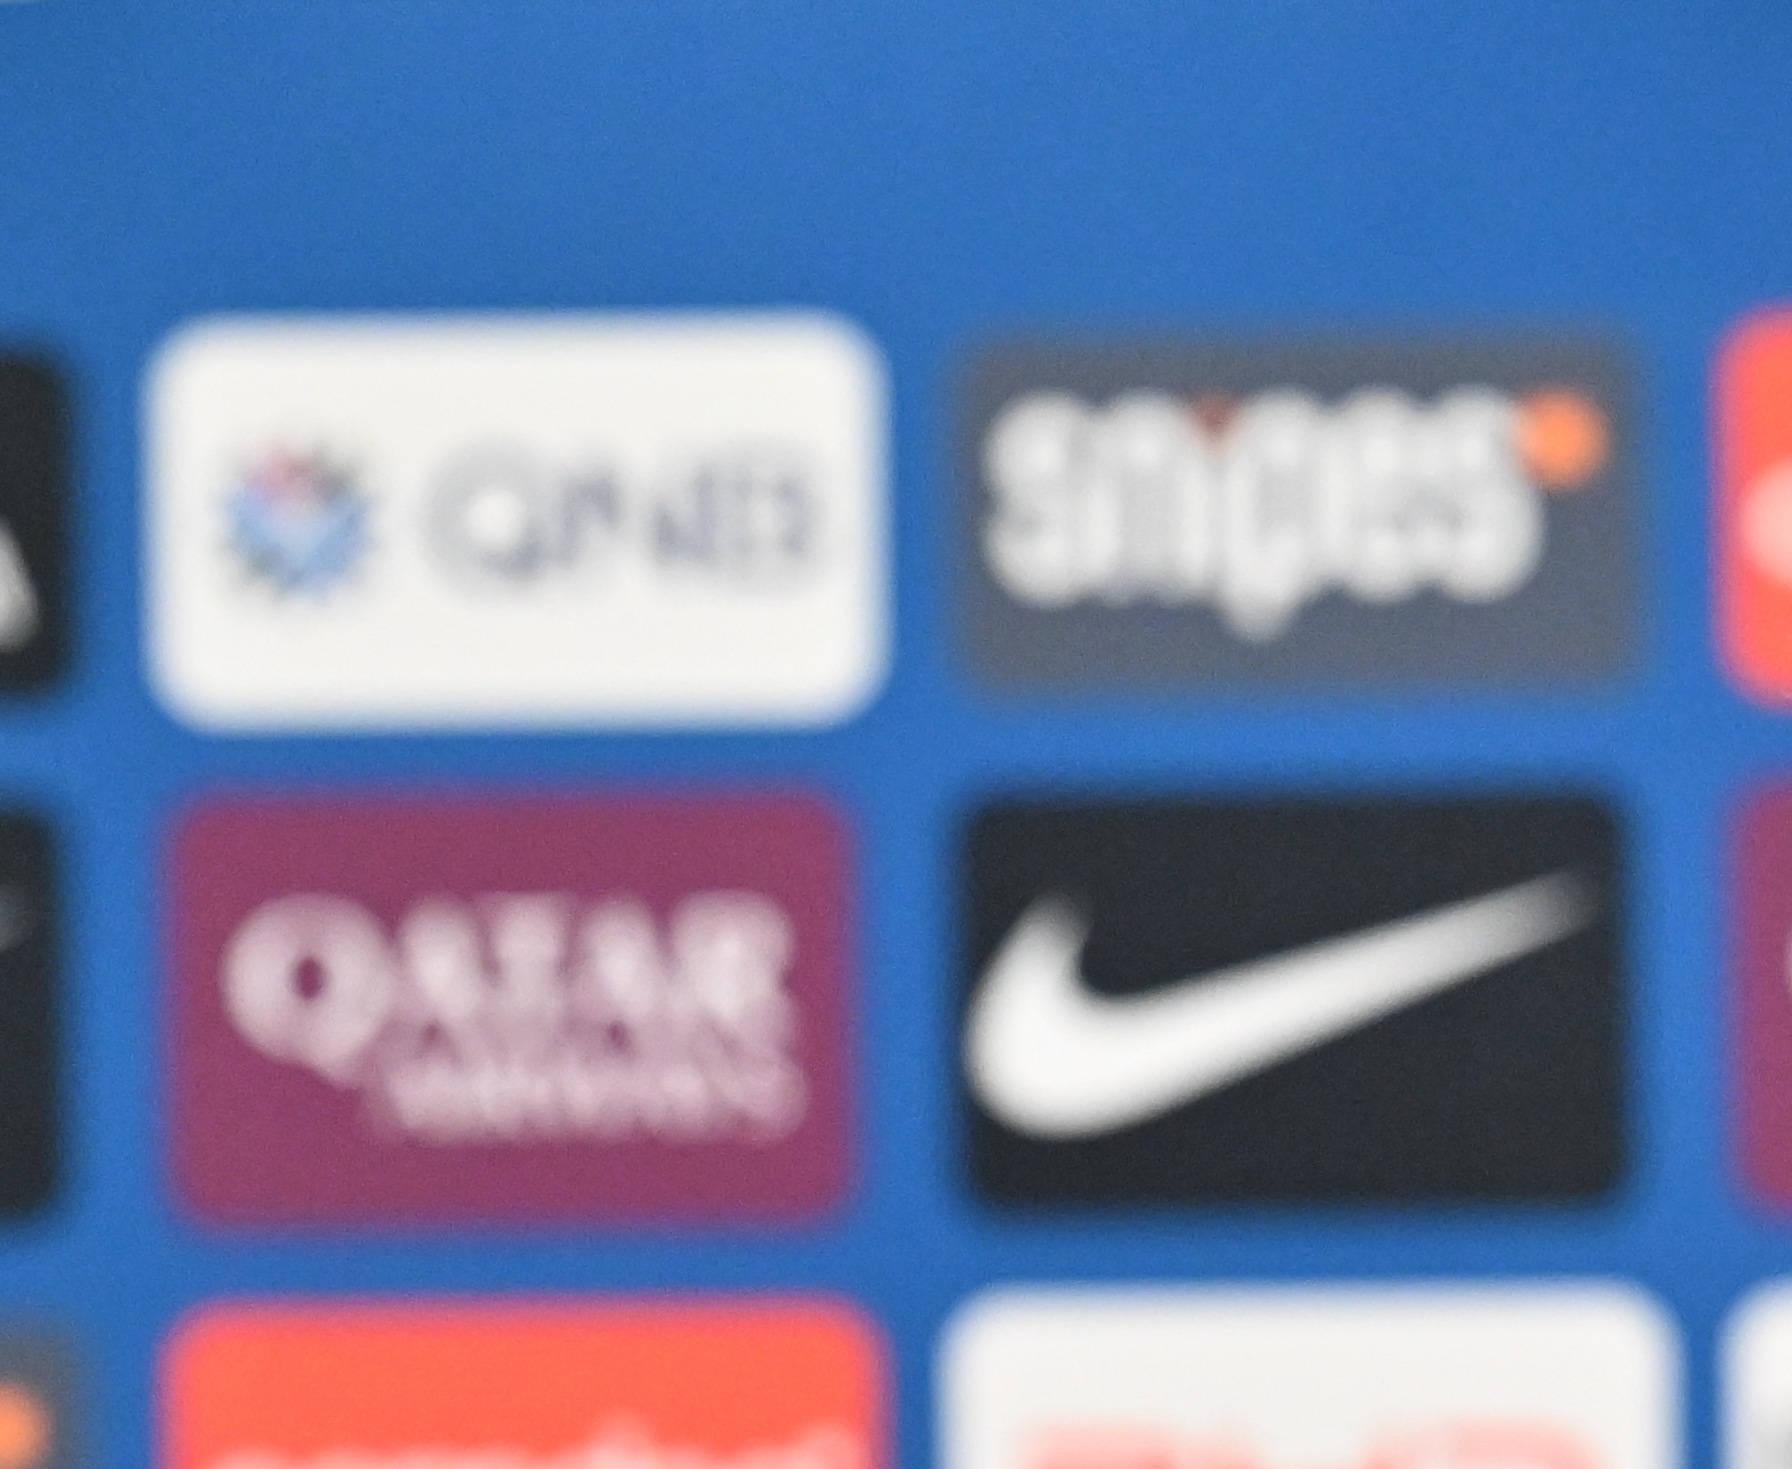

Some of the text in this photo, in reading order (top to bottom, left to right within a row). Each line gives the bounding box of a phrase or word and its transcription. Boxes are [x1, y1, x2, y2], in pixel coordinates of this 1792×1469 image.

[425, 445, 818, 590] QNB
[985, 385, 1545, 640] snipes
[215, 890, 797, 1088] QATAR
